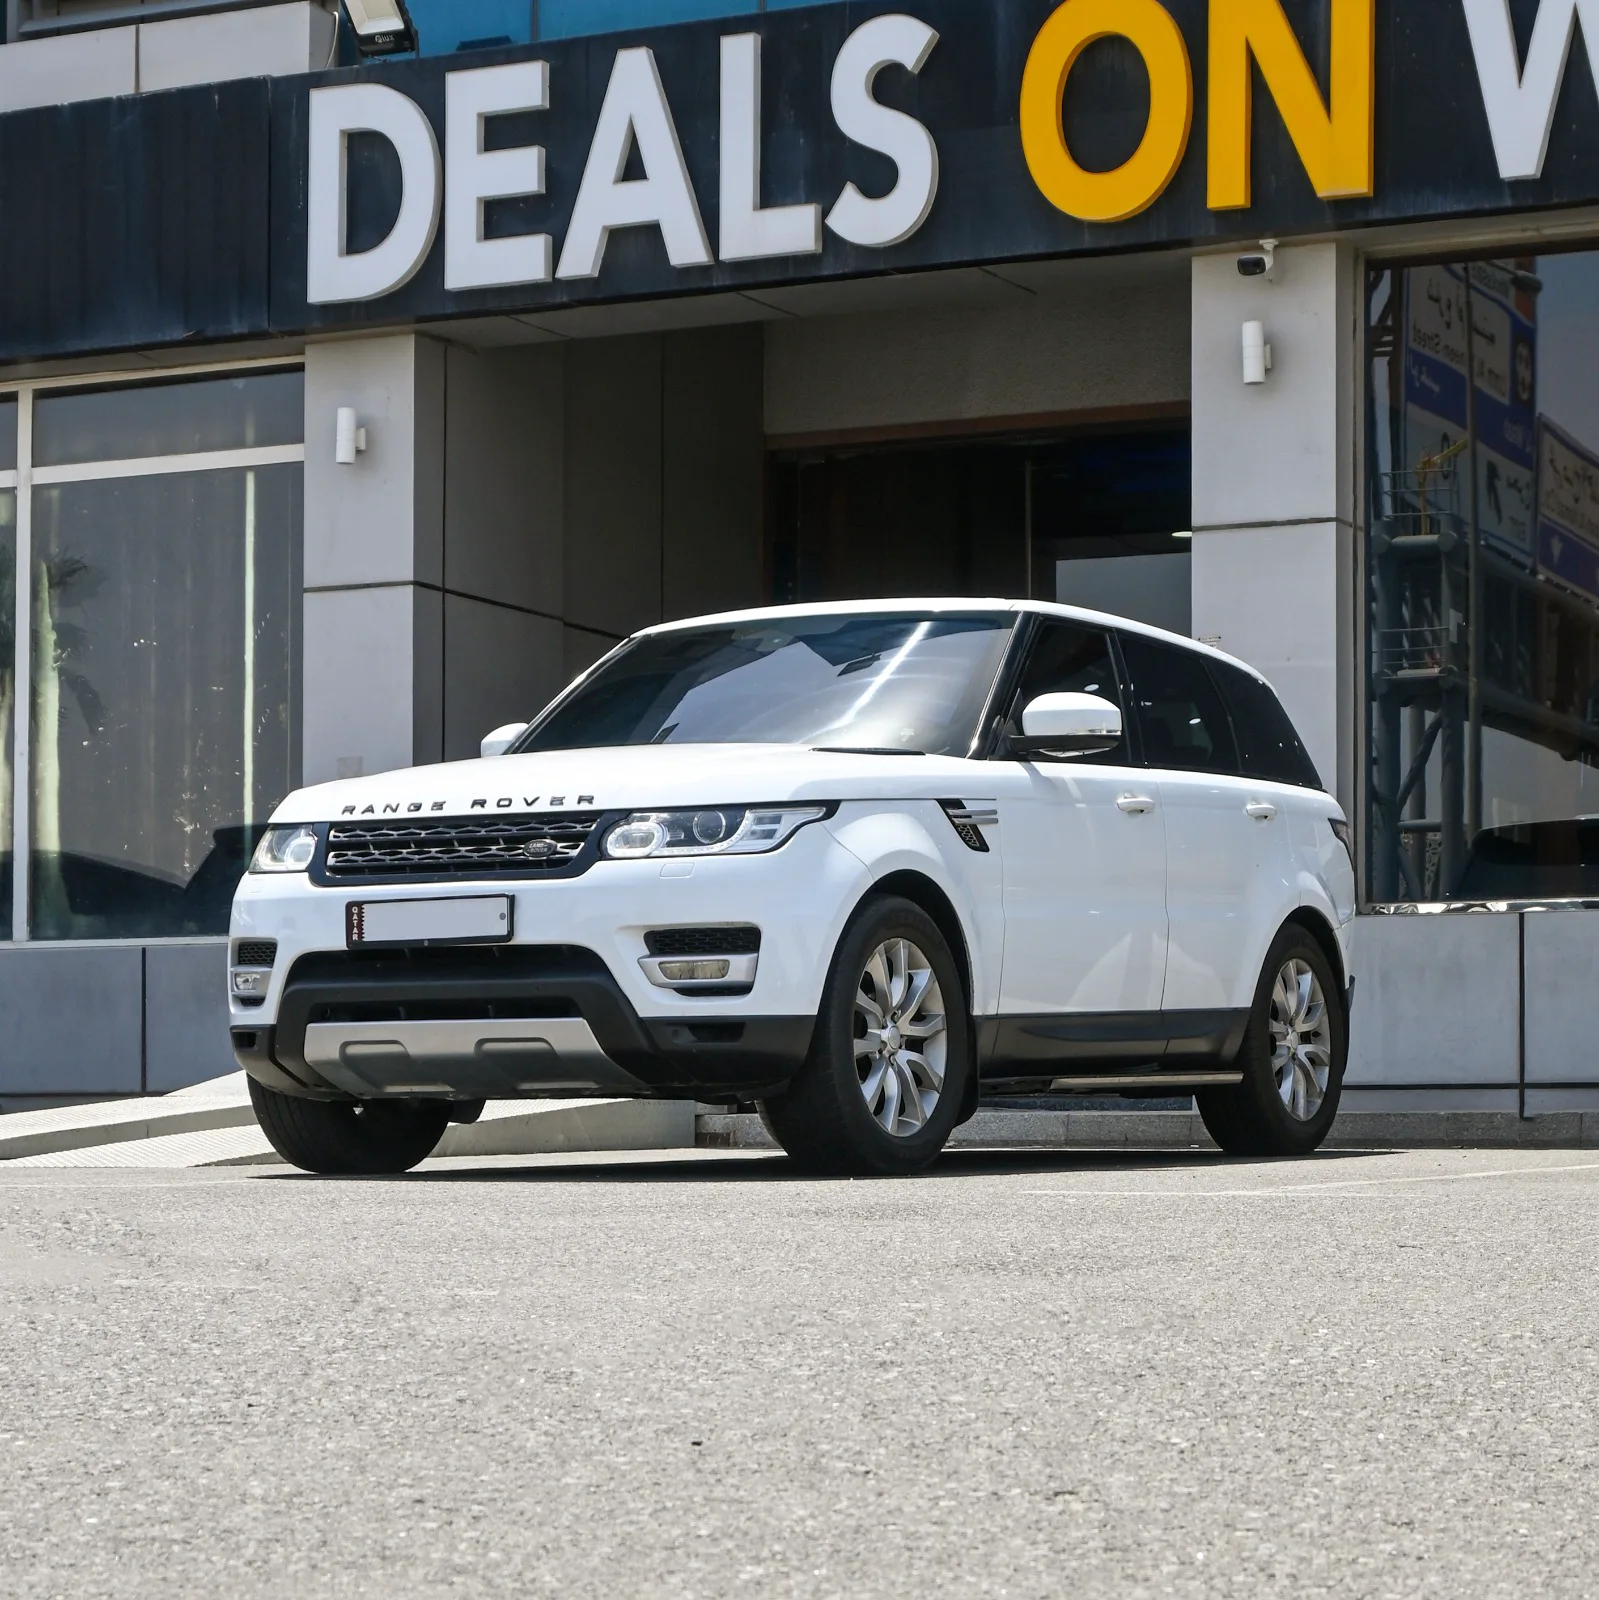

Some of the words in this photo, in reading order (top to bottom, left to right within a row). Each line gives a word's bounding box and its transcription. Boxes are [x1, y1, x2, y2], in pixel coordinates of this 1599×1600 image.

[306, 14, 940, 305] DEALS
[1020, 0, 1374, 223] ON
[341, 800, 446, 816] RANGE
[470, 795, 595, 810] ROVER
